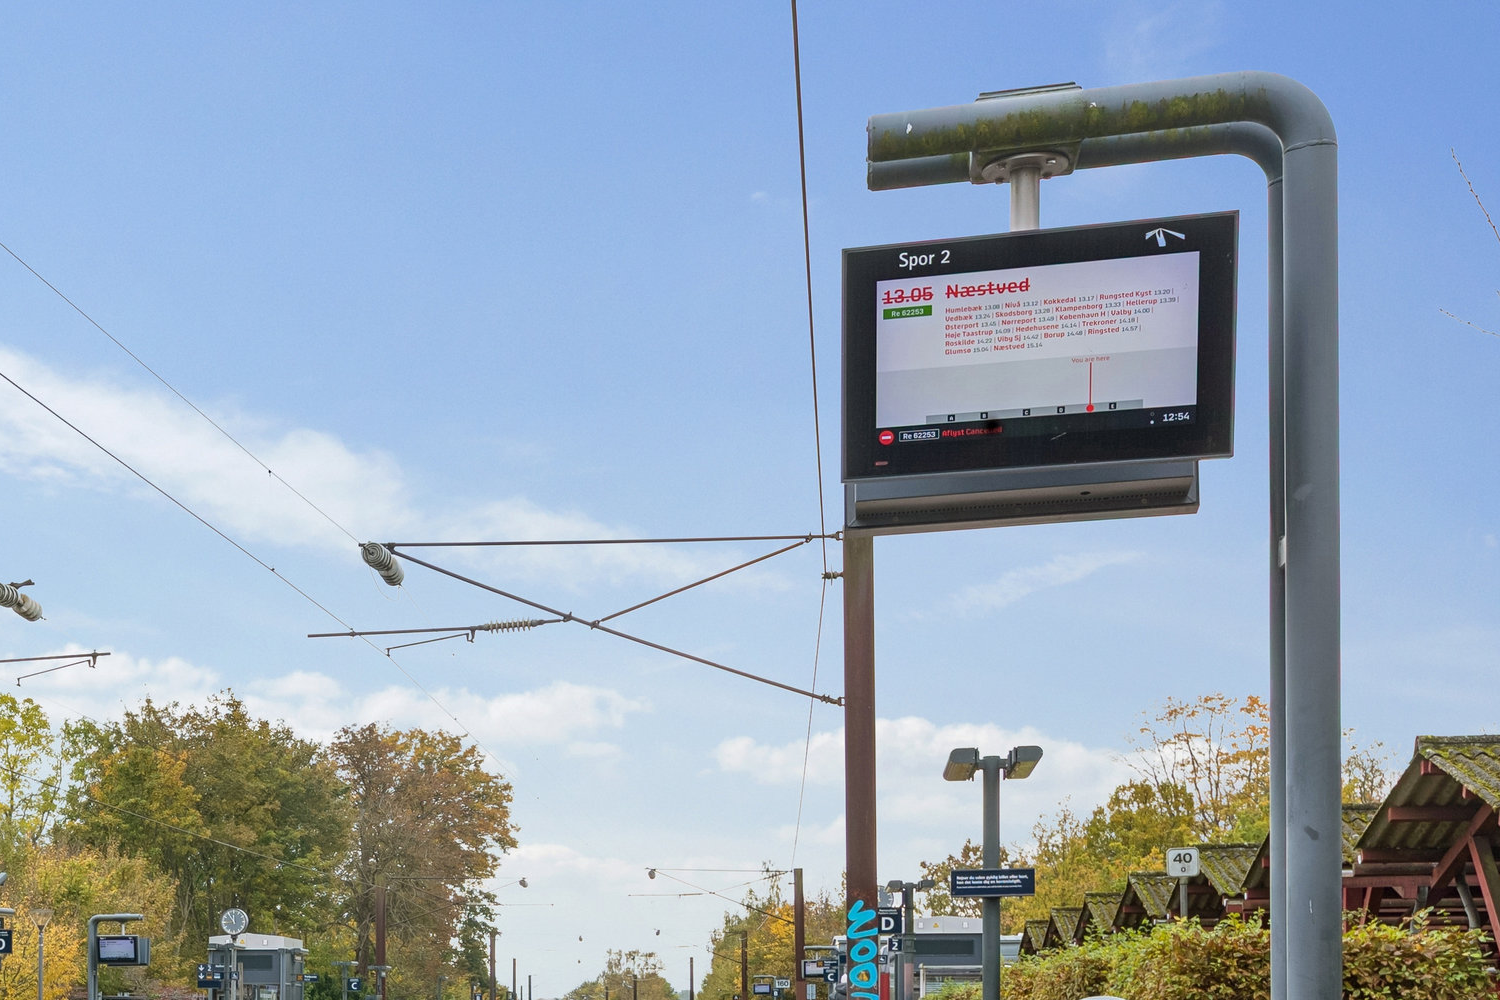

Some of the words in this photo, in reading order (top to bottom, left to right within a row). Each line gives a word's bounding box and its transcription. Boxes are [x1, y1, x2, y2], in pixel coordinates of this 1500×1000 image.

[899, 252, 935, 270] Spor
[941, 250, 950, 264] 2
[883, 287, 933, 304] 13.05
[946, 278, 1030, 299] Næstved
[945, 305, 982, 314] Humlebæk
[1043, 297, 1077, 305] Kokkedal
[1099, 291, 1134, 301] Rungsted
[1135, 290, 1152, 298] Kyst
[902, 308, 924, 317] 62253
[945, 314, 973, 322] Vedbæk
[995, 309, 1033, 318] Skodsborg
[1055, 304, 1103, 313] Klampenborg
[1126, 298, 1158, 307] Hellerup
[945, 322, 979, 331] Østerport
[1001, 317, 1036, 326] Nørreport
[1059, 312, 1099, 321] København
[1111, 308, 1132, 316] Valby
[945, 331, 961, 339] Høje
[963, 328, 993, 337] Taastrup
[1016, 323, 1059, 332] Hedehusene
[1082, 318, 1117, 327] Trekroner
[945, 338, 975, 347] Roskilde
[997, 335, 1013, 343] Viby
[1043, 331, 1065, 339] Borup
[1088, 327, 1120, 335] Ringsted
[945, 347, 971, 355] Glumsø
[993, 343, 1025, 351] Næstved
[1162, 412, 1190, 422] 12:54
[913, 431, 936, 439] 62253
[1173, 853, 1192, 863] 40
[881, 917, 894, 931] D
[892, 942, 898, 951] 2
[827, 973, 834, 981] C
[351, 982, 358, 990] C
